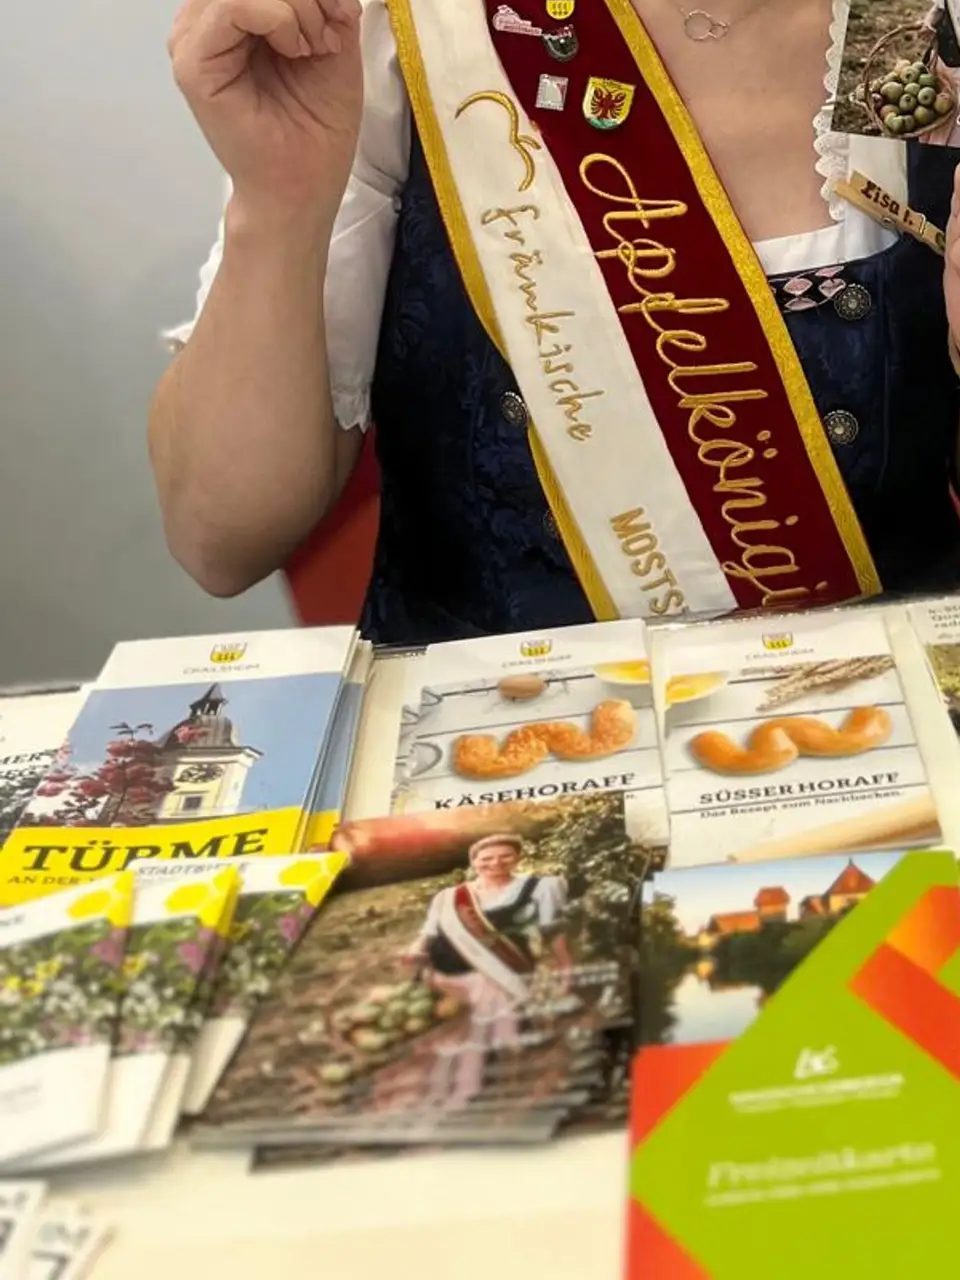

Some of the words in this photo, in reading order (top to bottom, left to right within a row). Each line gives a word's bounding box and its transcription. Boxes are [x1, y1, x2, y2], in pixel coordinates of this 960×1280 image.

[610, 506, 690, 616] MOSTS
[433, 772, 636, 810] KÄSEHORAFF
[700, 783, 794, 805] SÜSSER
[797, 772, 900, 793] HORAFF
[22, 828, 269, 872] TÜRME
